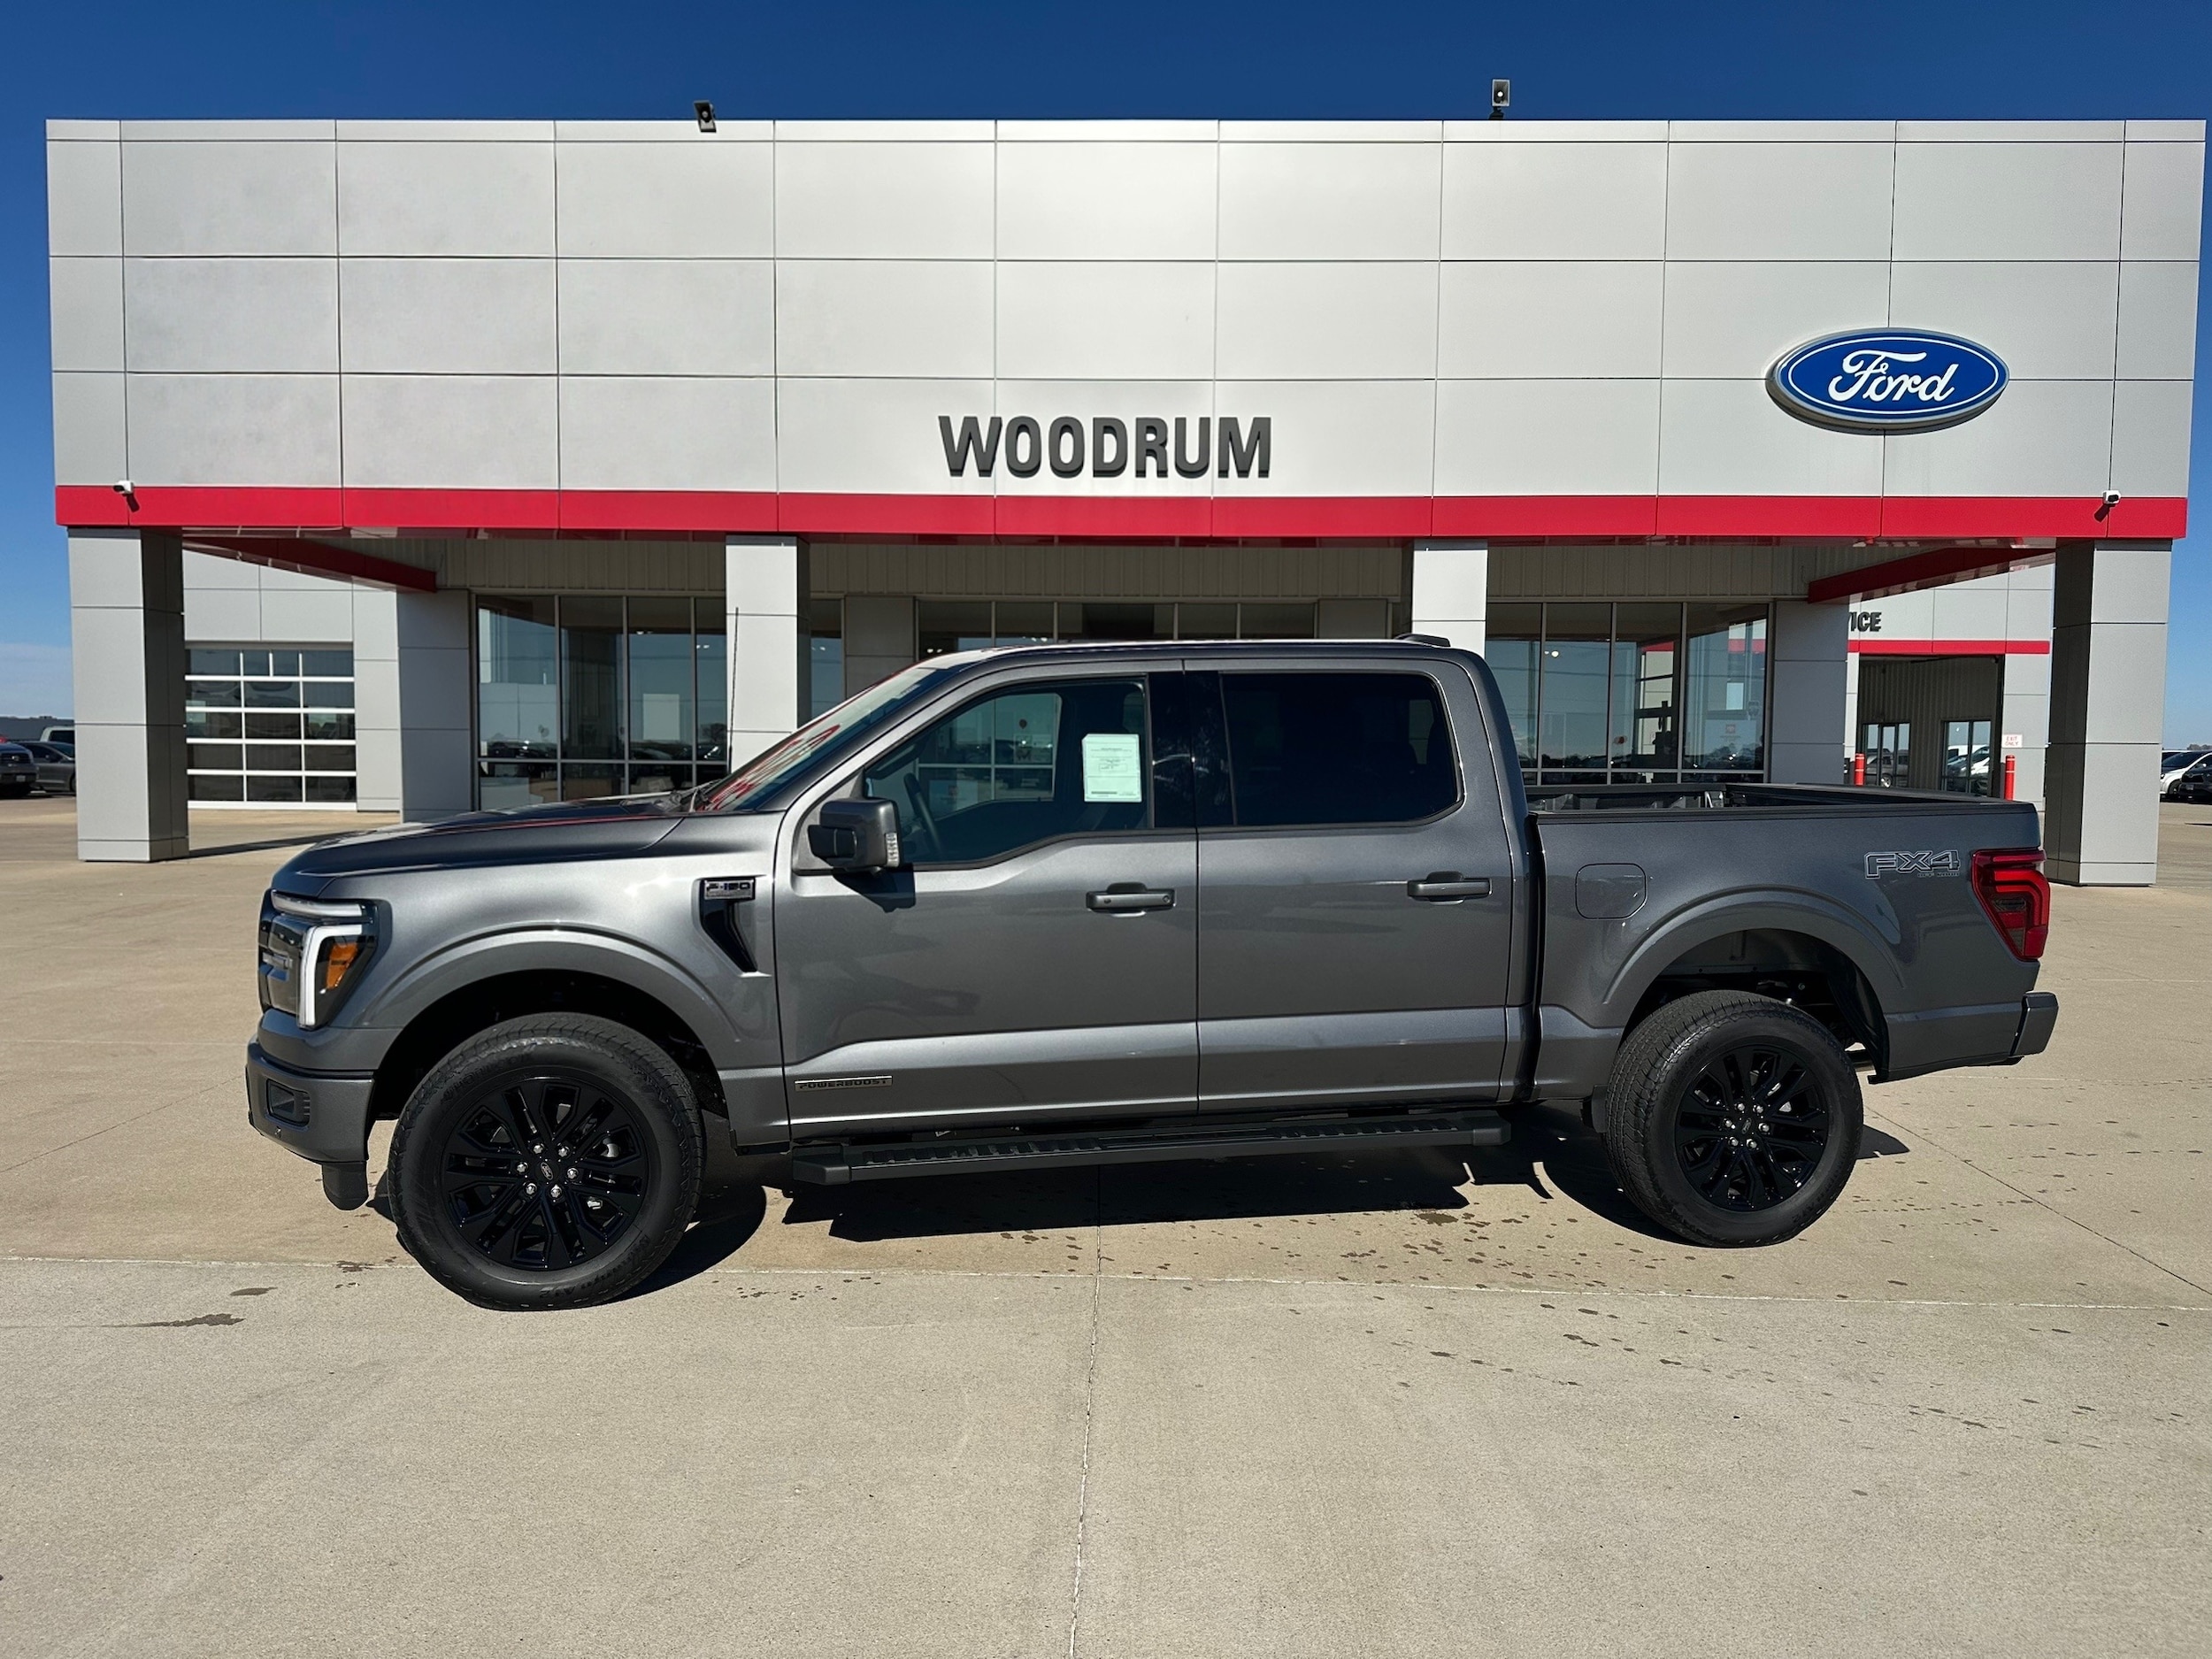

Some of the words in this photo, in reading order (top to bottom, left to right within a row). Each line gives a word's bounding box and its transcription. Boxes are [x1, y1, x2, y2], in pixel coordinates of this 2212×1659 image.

[1828, 349, 1959, 402] Ford
[938, 416, 1271, 478] WOODRUM
[1848, 611, 1882, 632] ICE
[1864, 849, 1961, 879] FX4
[799, 1079, 887, 1089] POWERBOOST
